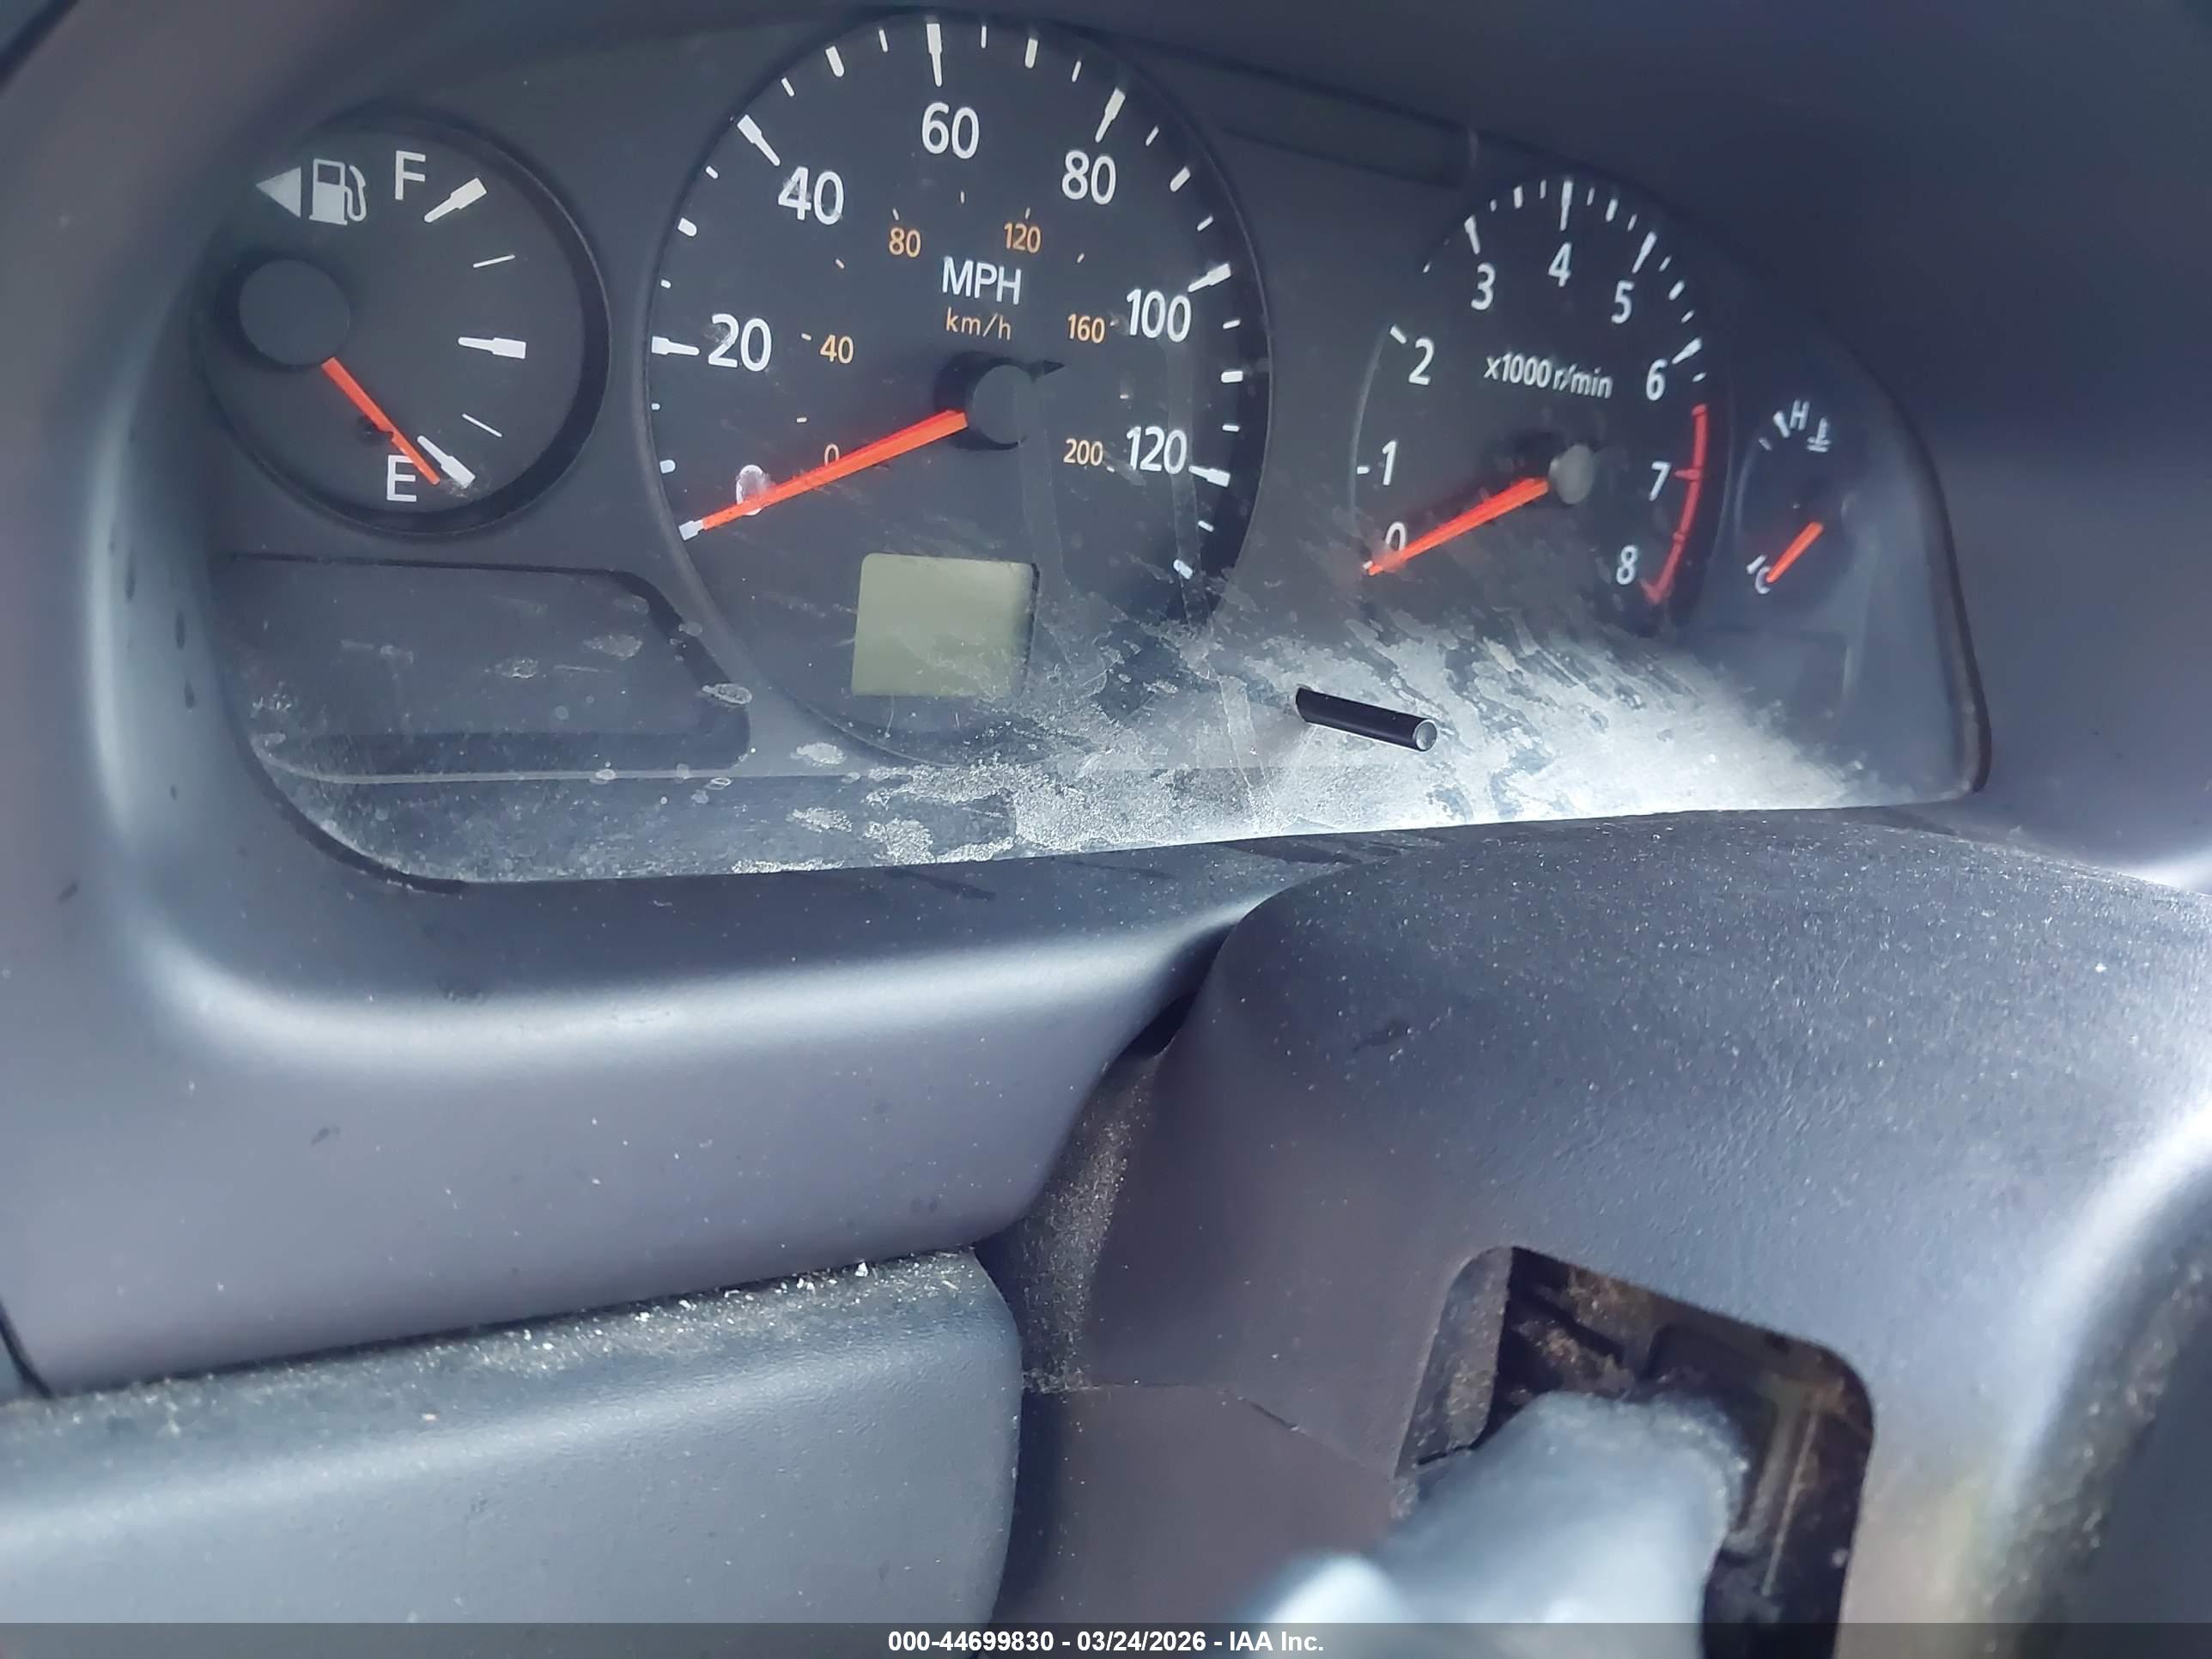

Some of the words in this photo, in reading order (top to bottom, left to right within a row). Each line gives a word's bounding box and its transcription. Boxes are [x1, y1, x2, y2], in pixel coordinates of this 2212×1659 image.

[921, 102, 980, 158] 60
[395, 150, 426, 200] F
[778, 167, 845, 225] 40
[1062, 150, 1117, 204] 80
[889, 228, 921, 258] 80
[1004, 222, 1042, 253] 120
[942, 258, 1023, 305] MPH
[1548, 240, 1572, 286] 4
[1471, 263, 1496, 310] 3
[1611, 280, 1634, 324] 5
[945, 307, 1012, 341] km/h
[1067, 313, 1105, 343] 160
[1126, 289, 1192, 343] 100
[708, 314, 772, 371] 20
[819, 336, 854, 364] 40
[1408, 337, 1435, 386] 2
[1483, 351, 1552, 388] x1000
[1552, 363, 1614, 399] r/min
[1645, 358, 1667, 401] 6
[1790, 399, 1810, 430] H
[1063, 439, 1103, 466] 200
[1125, 427, 1188, 474] 120
[1381, 440, 1399, 486] 1
[386, 454, 417, 501] E
[1649, 461, 1670, 501] 7
[1615, 546, 1638, 585] 8
